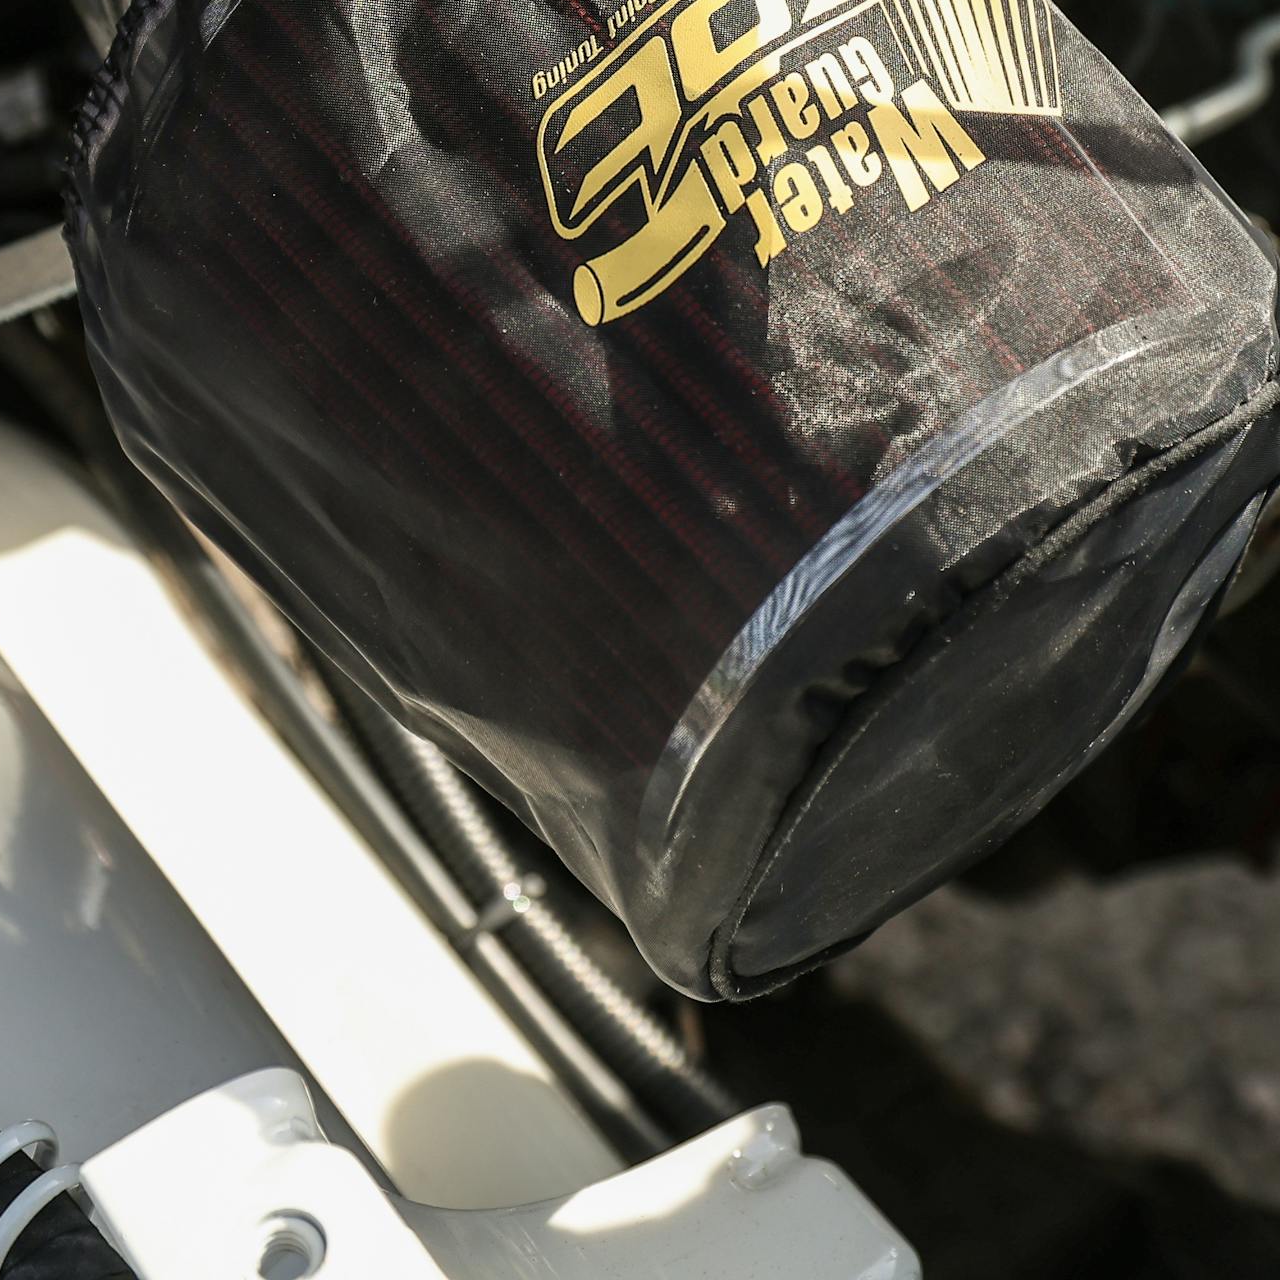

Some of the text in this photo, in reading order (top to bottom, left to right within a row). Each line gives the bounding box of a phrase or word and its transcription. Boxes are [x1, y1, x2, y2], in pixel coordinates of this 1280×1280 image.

[531, 34, 604, 100] Tuning
[699, 36, 894, 214] Guard
[746, 78, 986, 268] Water
